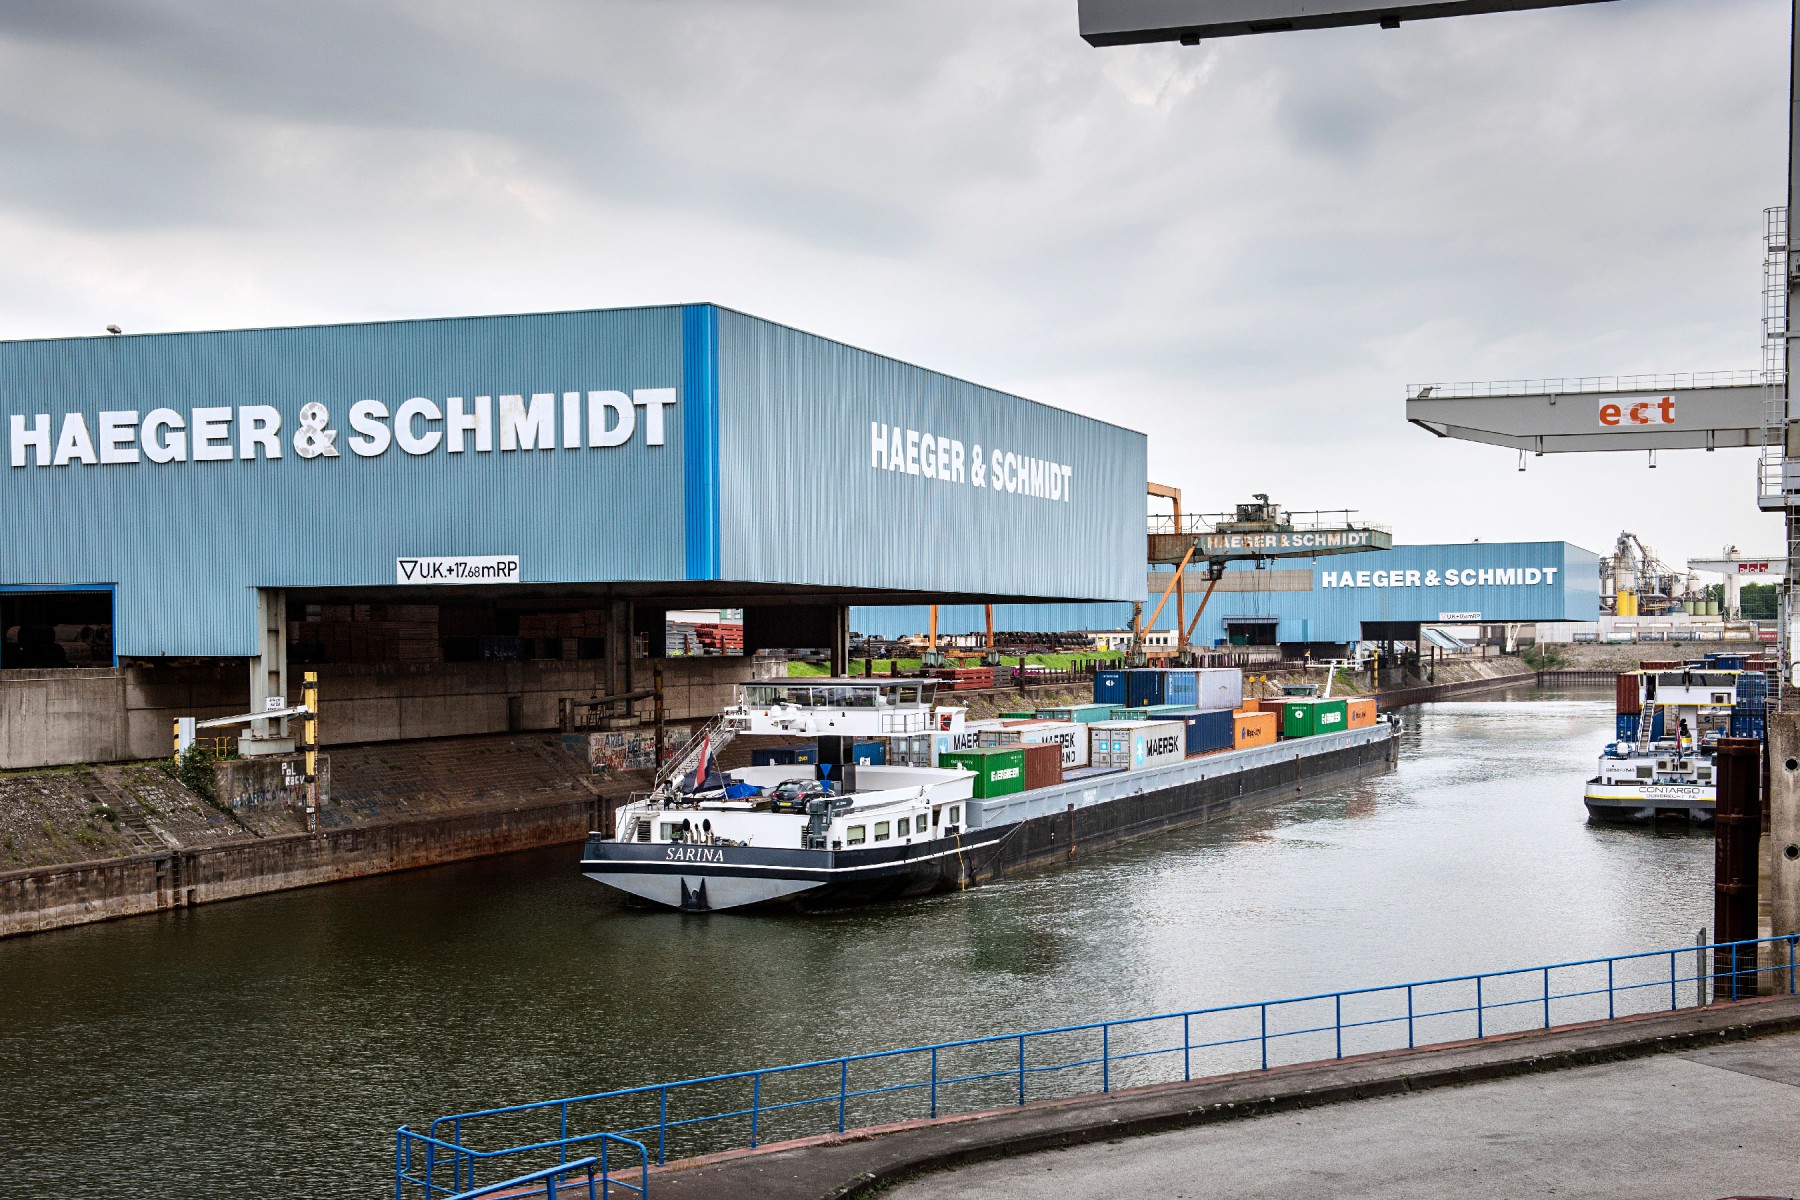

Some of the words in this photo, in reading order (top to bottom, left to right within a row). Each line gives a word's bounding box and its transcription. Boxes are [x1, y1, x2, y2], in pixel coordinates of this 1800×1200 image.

[1599, 396, 1675, 426] ect
[10, 404, 283, 467] HAEGER
[293, 401, 341, 459] &
[348, 387, 677, 458] SCHMIDT
[871, 421, 965, 484] HAEGER
[971, 444, 987, 488] &
[991, 448, 1072, 503] SCHMIDT
[1207, 535, 1277, 549] HAEGER
[1279, 534, 1291, 547] &
[1292, 532, 1369, 547] SCHMIDT
[1322, 570, 1421, 588] HAEGER
[1424, 569, 1441, 587] &
[1444, 567, 1558, 587] SCHMIDT
[953, 732, 979, 751] MAER
[1146, 735, 1179, 757] MAERSK
[1638, 786, 1701, 795] CONTARGO
[665, 847, 725, 863] SARINA
